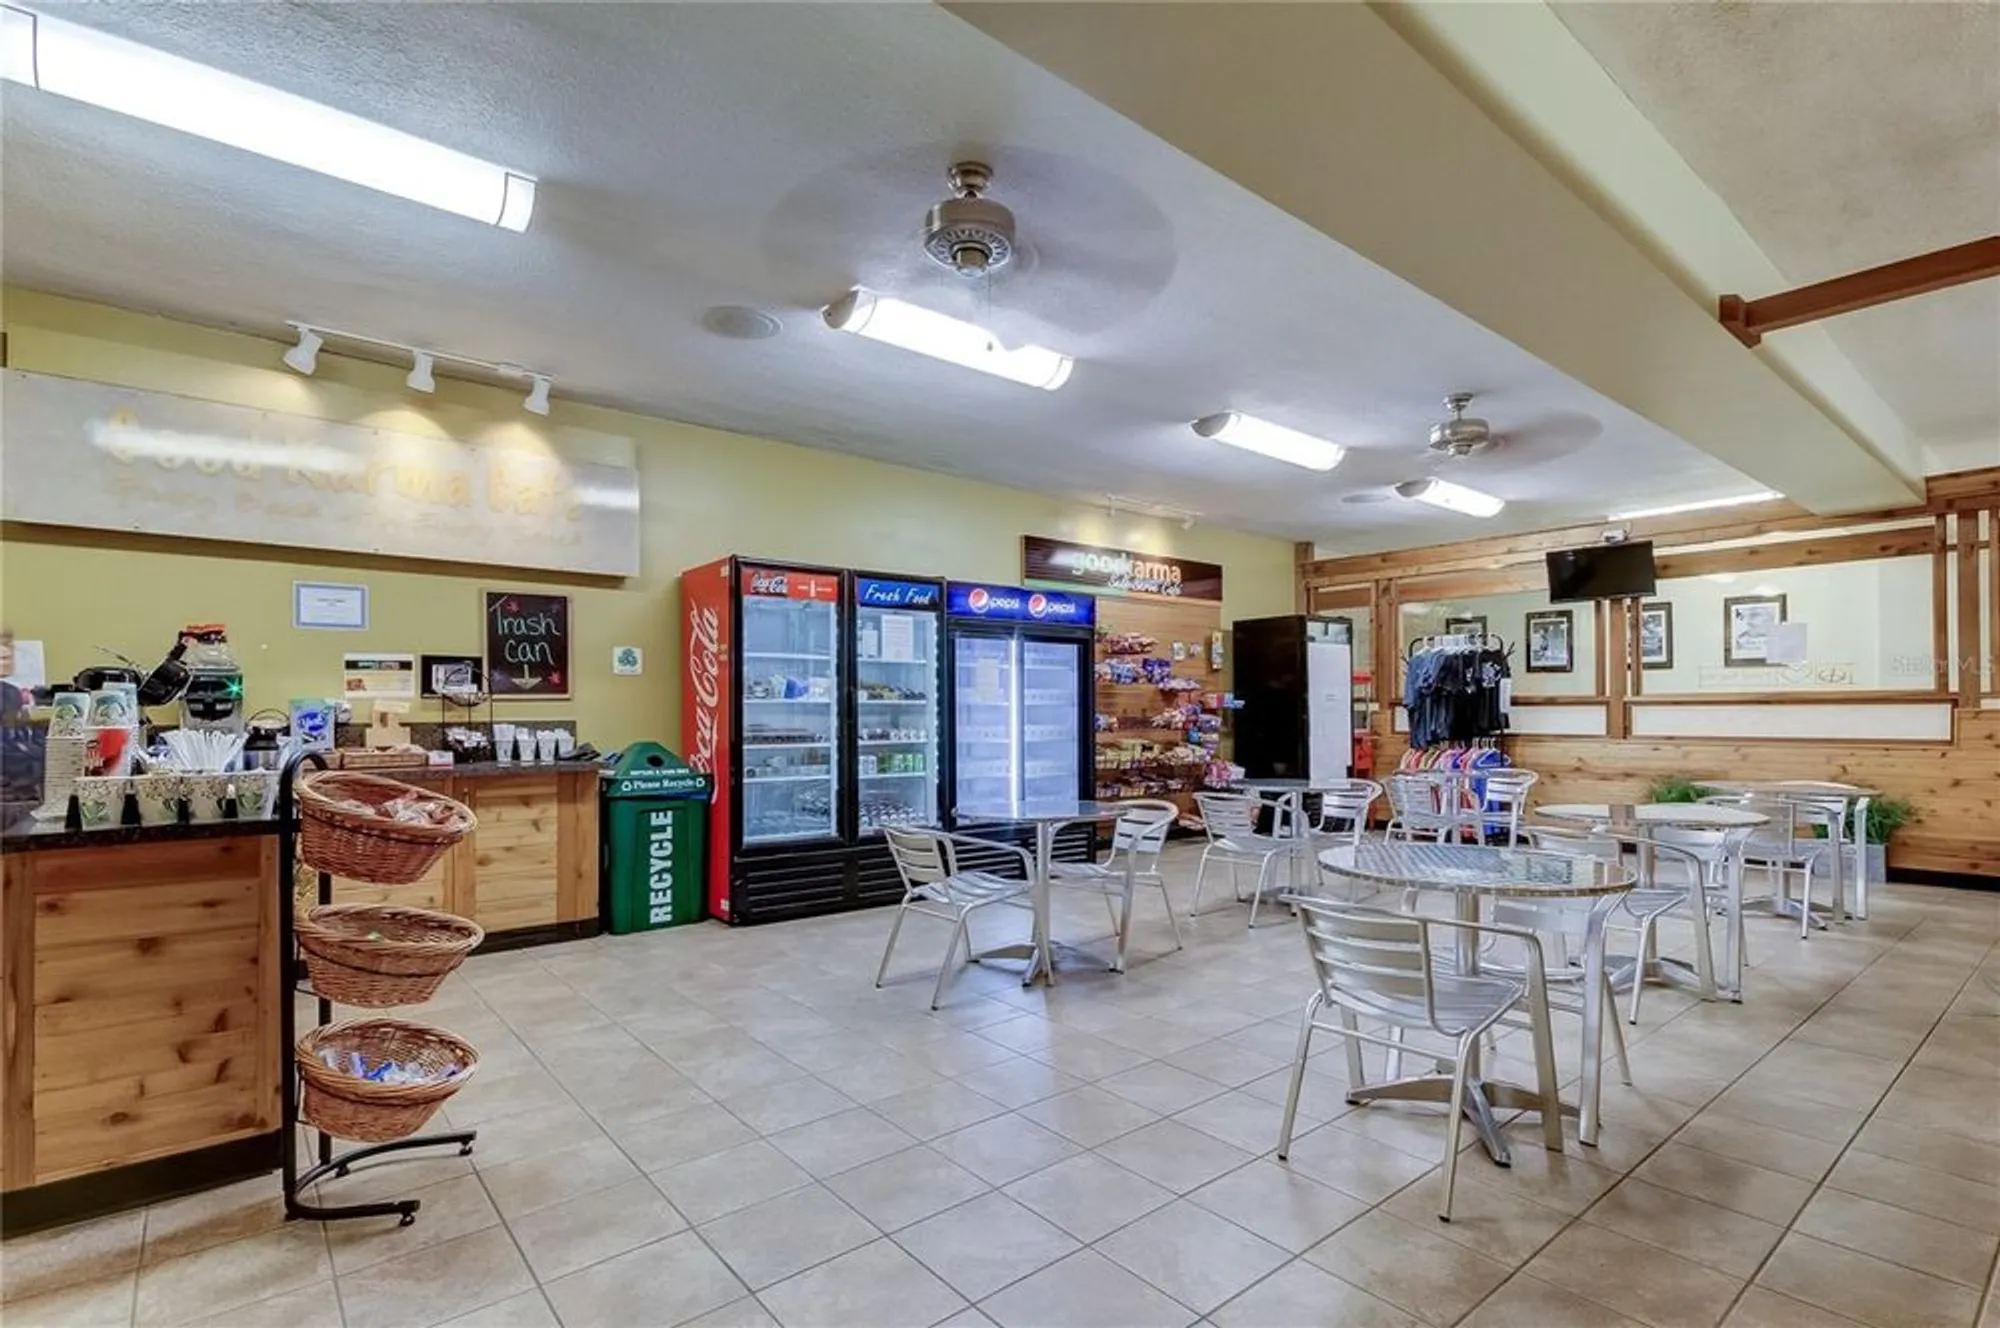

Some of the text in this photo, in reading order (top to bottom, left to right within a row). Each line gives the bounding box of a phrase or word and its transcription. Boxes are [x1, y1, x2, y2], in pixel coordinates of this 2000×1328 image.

[864, 583, 932, 605] Fresh Food
[988, 597, 1020, 609] pepsi
[1046, 602, 1076, 614] pepsi
[489, 595, 561, 636] Trash
[633, 778, 696, 790] Please Recycle
[650, 810, 673, 924] RECYCLE
